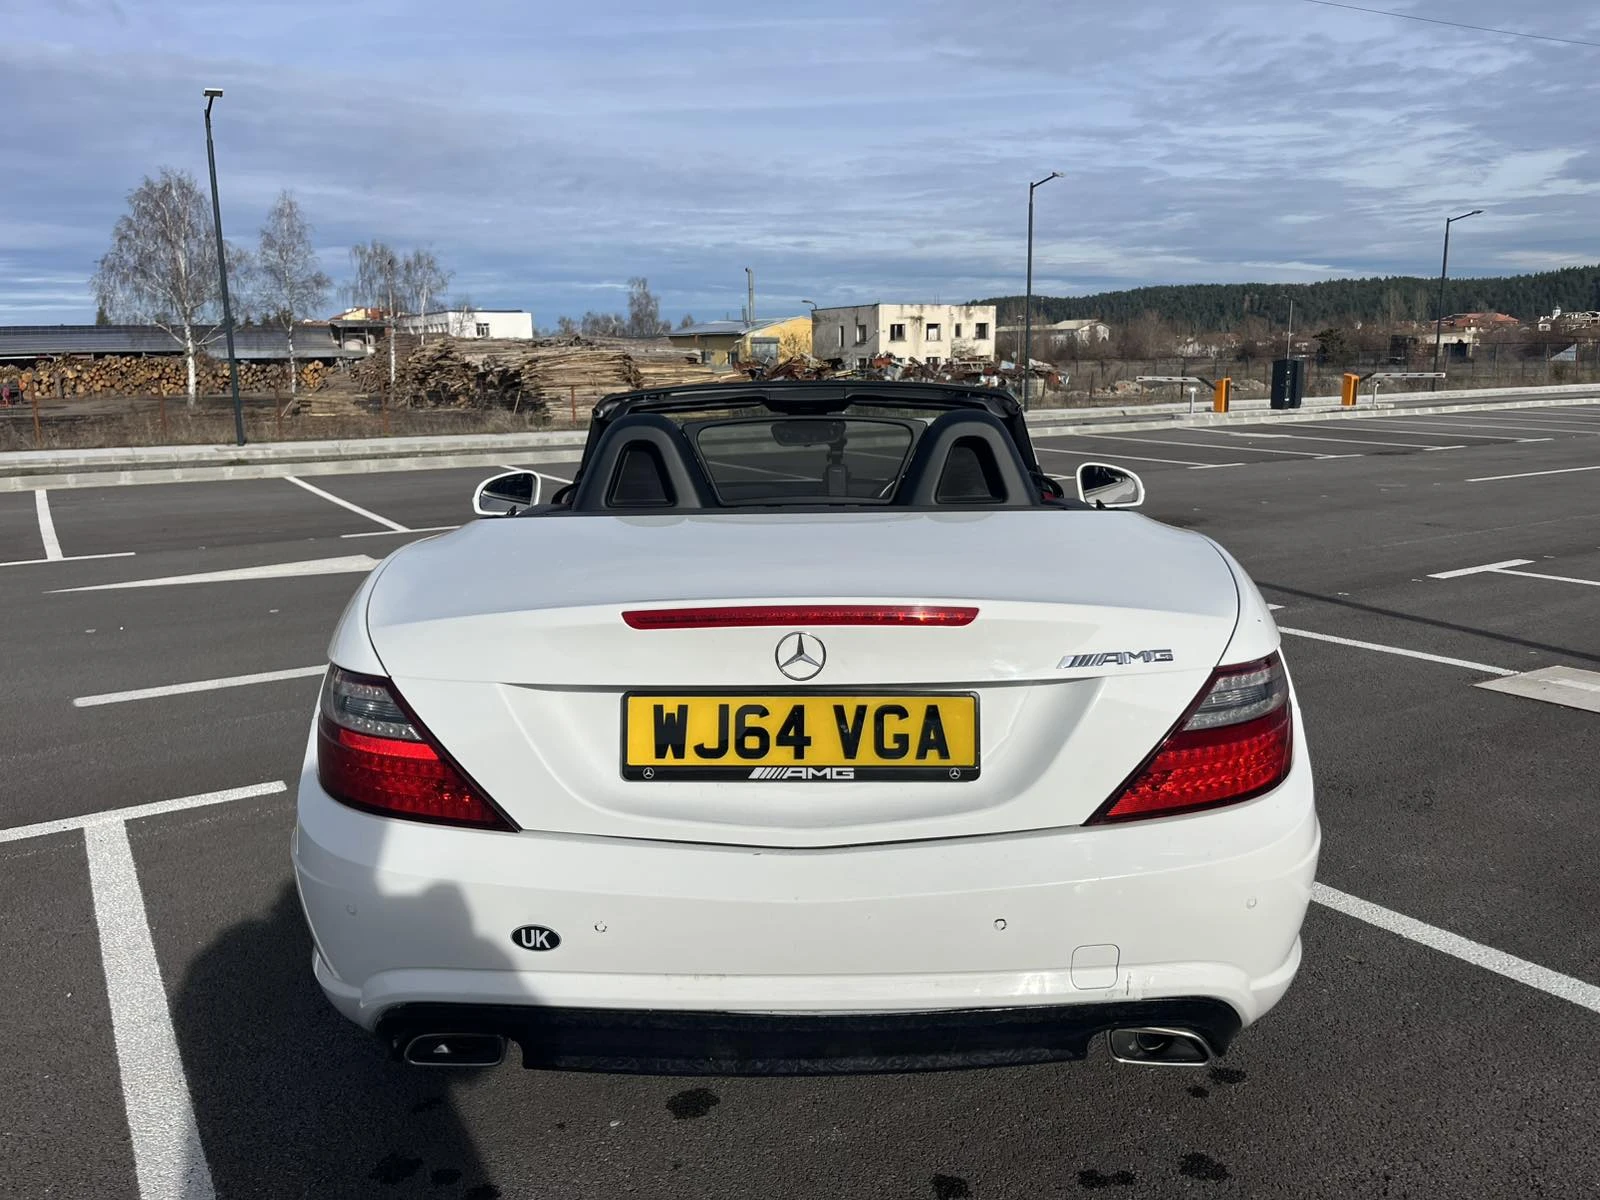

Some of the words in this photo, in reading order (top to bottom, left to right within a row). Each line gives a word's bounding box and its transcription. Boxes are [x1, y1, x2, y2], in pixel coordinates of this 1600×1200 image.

[1096, 649, 1174, 666] AMG
[653, 704, 812, 760] WJ64
[833, 704, 950, 760] VGA
[782, 767, 854, 779] AMG
[521, 929, 550, 948] UK
